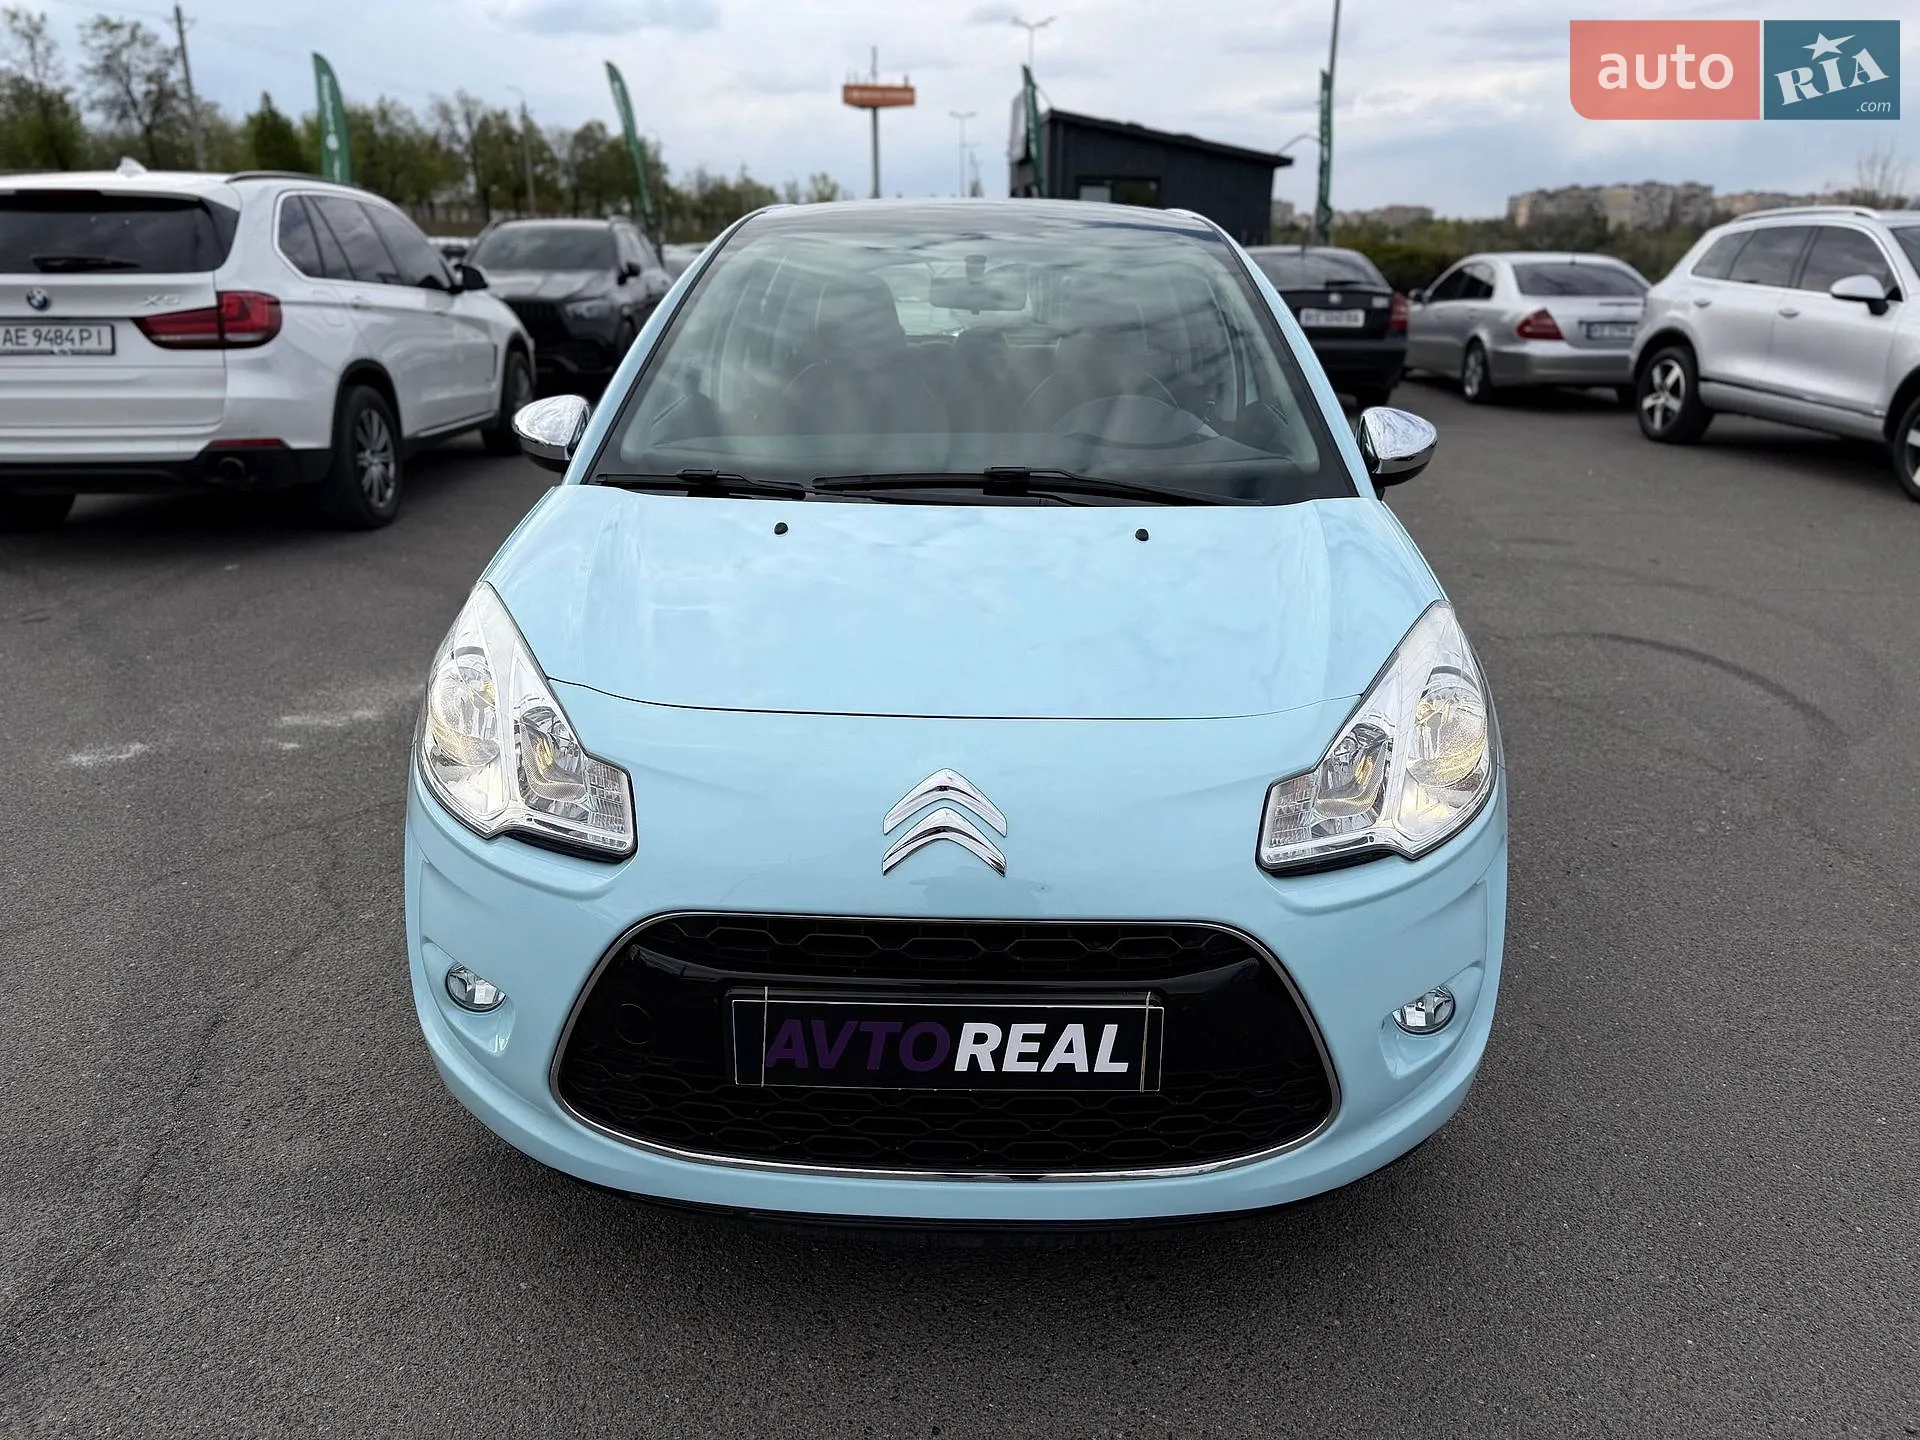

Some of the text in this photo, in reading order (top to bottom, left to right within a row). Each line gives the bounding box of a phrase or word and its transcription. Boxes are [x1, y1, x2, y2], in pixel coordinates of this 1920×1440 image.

[2, 328, 28, 346] AE
[33, 328, 75, 346] 9484
[765, 1019, 1130, 1073] AVTOREAL
